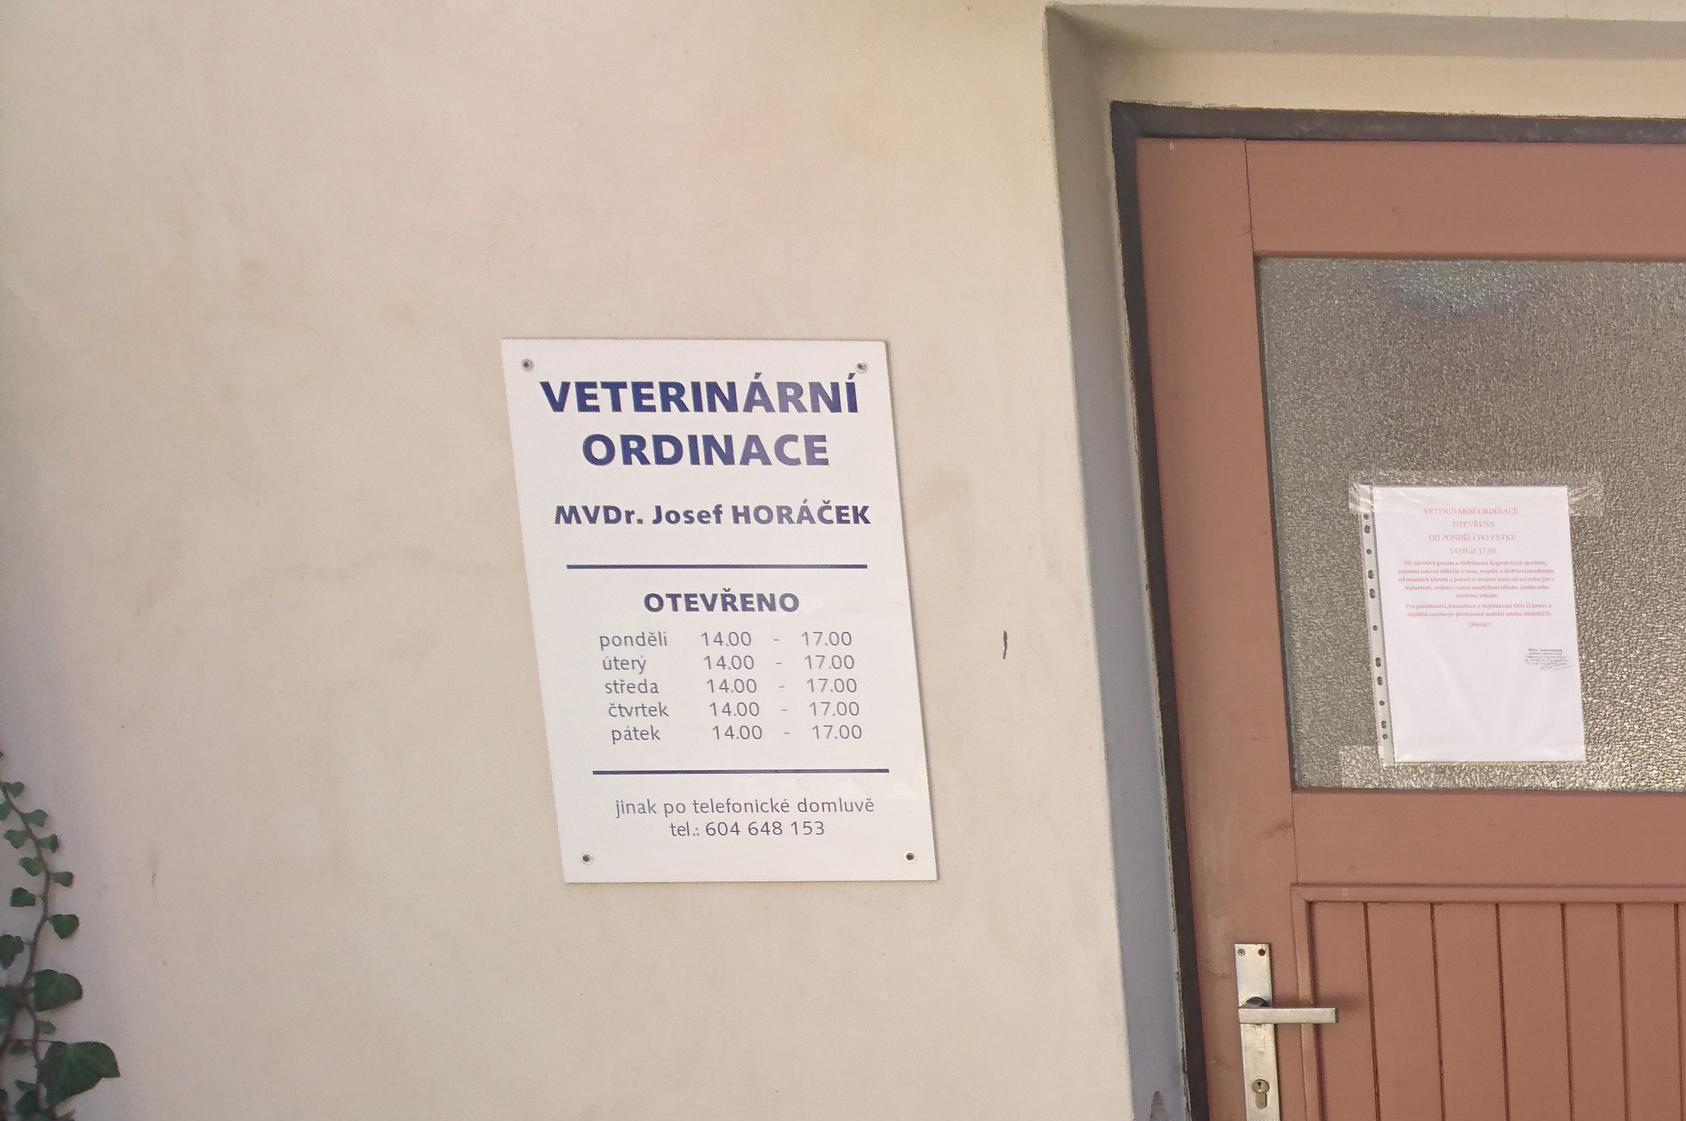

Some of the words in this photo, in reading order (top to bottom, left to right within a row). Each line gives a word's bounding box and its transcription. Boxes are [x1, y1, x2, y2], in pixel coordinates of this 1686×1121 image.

[540, 371, 859, 414] VETERINÁRNÍ
[582, 434, 829, 466] ORDINACE
[555, 505, 643, 524] MVDr.
[652, 504, 723, 524] Josef
[731, 498, 871, 524] HORÁČEK
[644, 588, 799, 612] OTEVŘENO
[600, 631, 667, 651] pondělí
[701, 632, 751, 647] 14.00
[802, 632, 852, 646] 17.00
[602, 655, 646, 675] úterý
[704, 655, 754, 670] 14.00
[804, 655, 854, 669] 17.00
[605, 679, 659, 694] středa
[707, 679, 757, 693] 14.00
[807, 678, 857, 693] 17.00
[608, 701, 669, 717] čtvrtek
[709, 702, 759, 717] 14.00
[809, 702, 859, 716] 17.00
[612, 725, 660, 745] pátek
[712, 725, 762, 740] 14.00
[812, 725, 862, 739] 17.00
[616, 798, 656, 818] jinak
[664, 803, 686, 818] po
[692, 797, 789, 813] telefonické
[797, 797, 874, 812] domluvě
[669, 821, 699, 836] tel.:
[706, 821, 740, 836] 604
[748, 821, 783, 836] 648
[791, 821, 824, 835] 153
